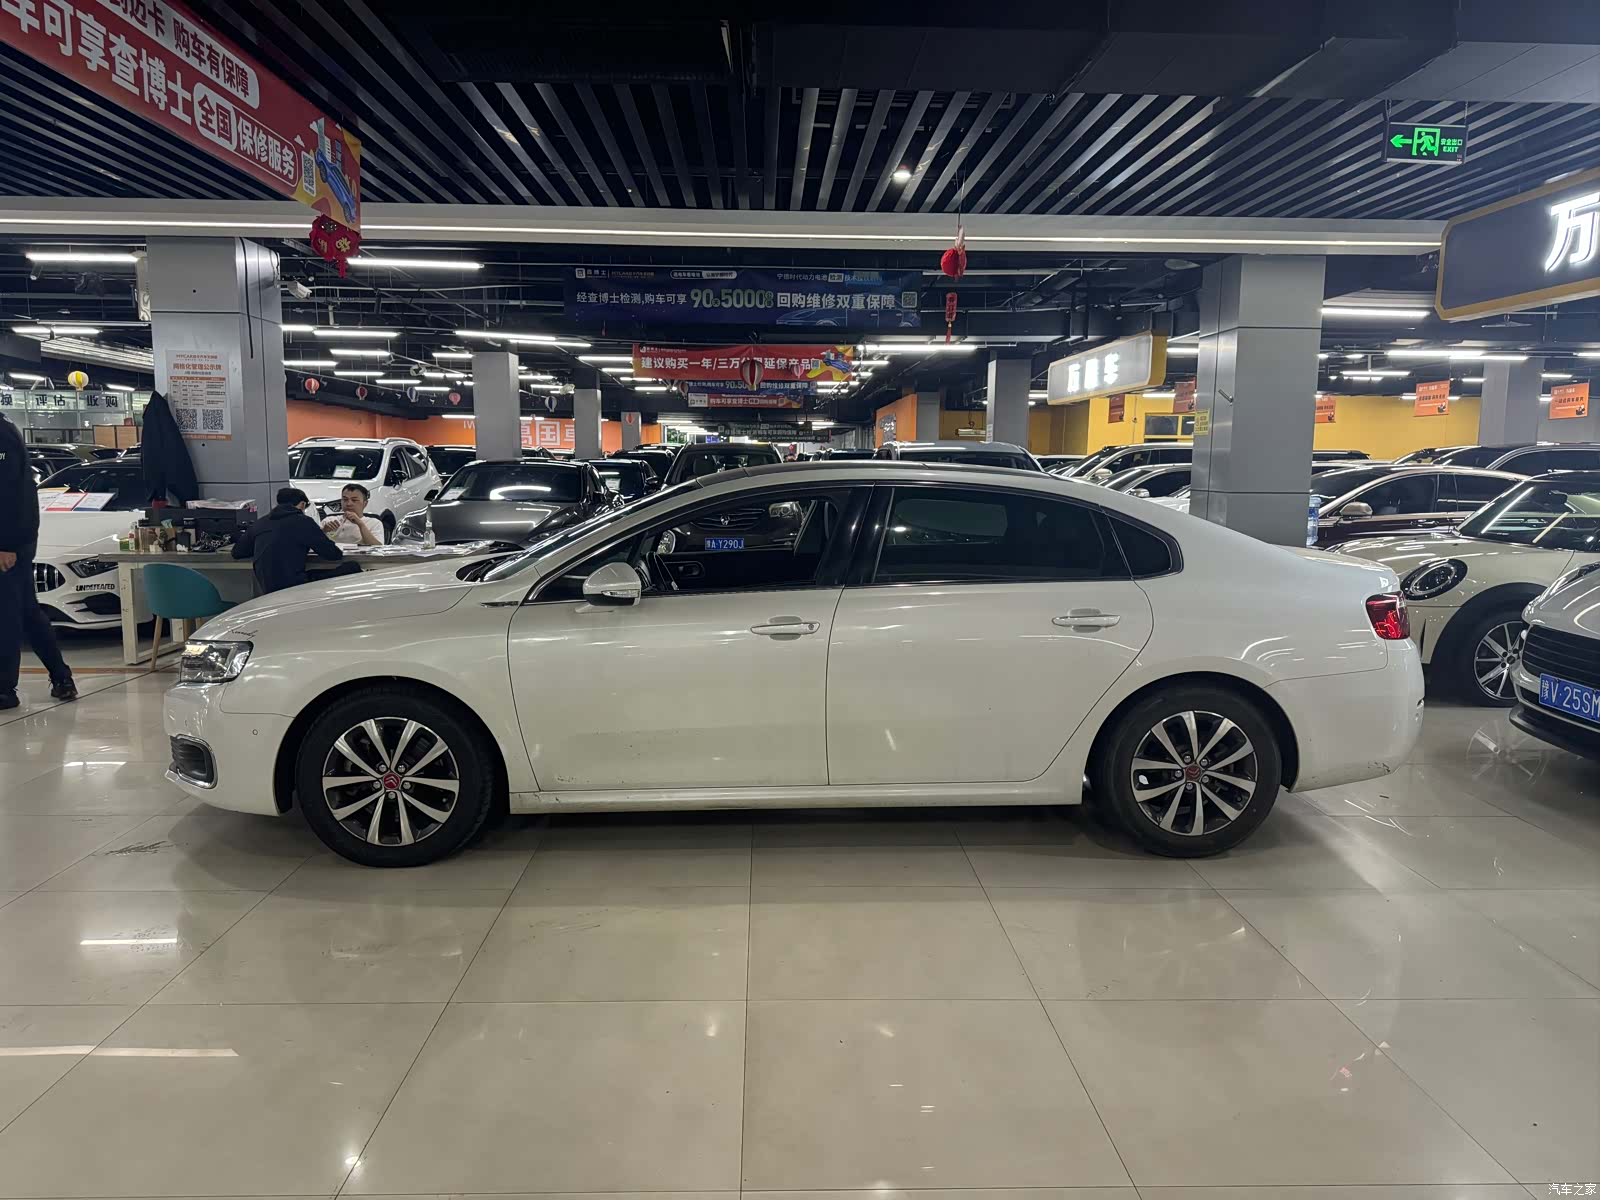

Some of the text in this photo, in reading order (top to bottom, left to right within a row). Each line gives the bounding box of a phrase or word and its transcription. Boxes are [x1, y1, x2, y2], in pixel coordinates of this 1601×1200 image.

[173, 18, 249, 98] 购车有保障
[199, 92, 232, 140] 全国
[237, 117, 295, 180] 保修服务
[1440, 138, 1463, 146] 安全出口
[776, 292, 896, 310] 回购维修双重保障
[641, 357, 811, 370] 建议购买一年/三万延保产品
[35, 394, 66, 406] 评估
[86, 395, 118, 407] 收购
[75, 583, 115, 592] UNDEFEATED
